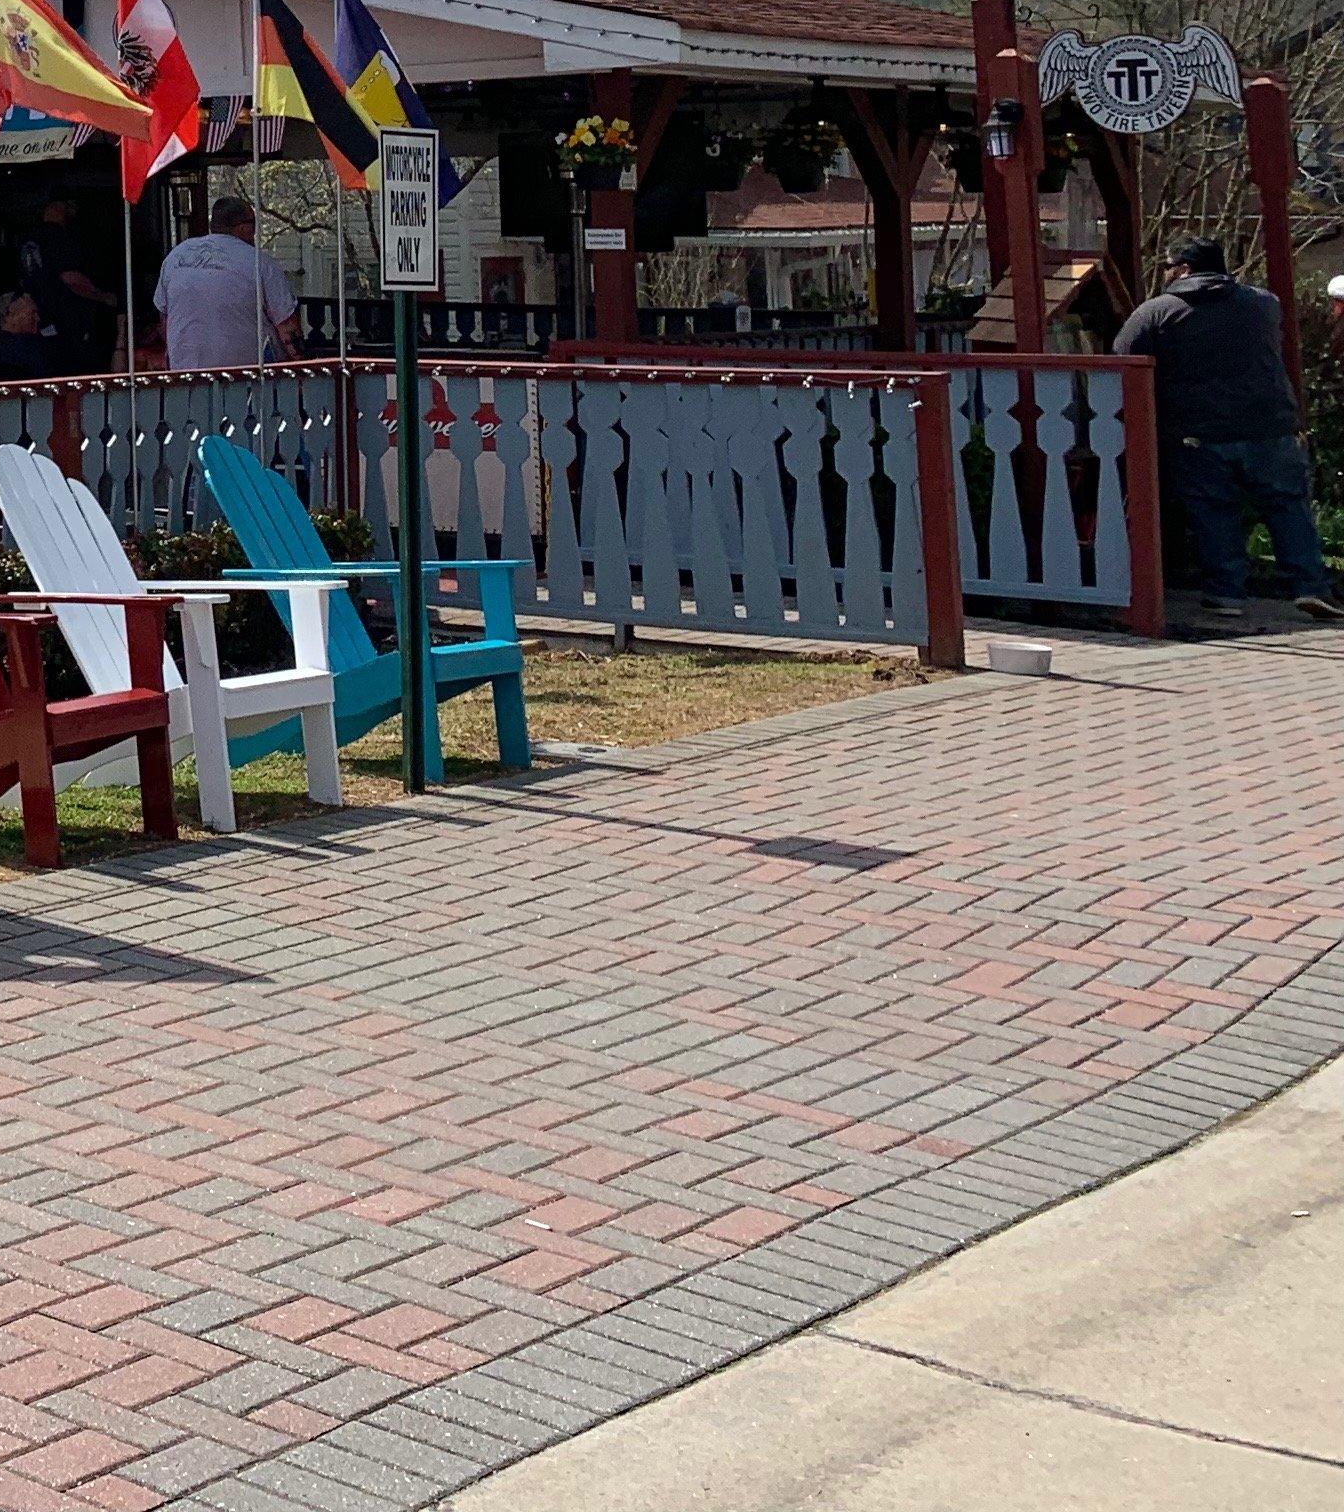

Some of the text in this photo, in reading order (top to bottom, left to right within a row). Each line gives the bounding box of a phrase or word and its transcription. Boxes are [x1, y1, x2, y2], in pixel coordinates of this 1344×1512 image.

[1107, 58, 1159, 102] TTT
[1078, 79, 1191, 132] TWO TIRE TAVERN
[22, 141, 41, 155] on
[42, 134, 69, 153] in!
[385, 144, 431, 183] MOTORCYCLE
[390, 190, 427, 228] PARKING
[397, 236, 421, 273] ONLY
